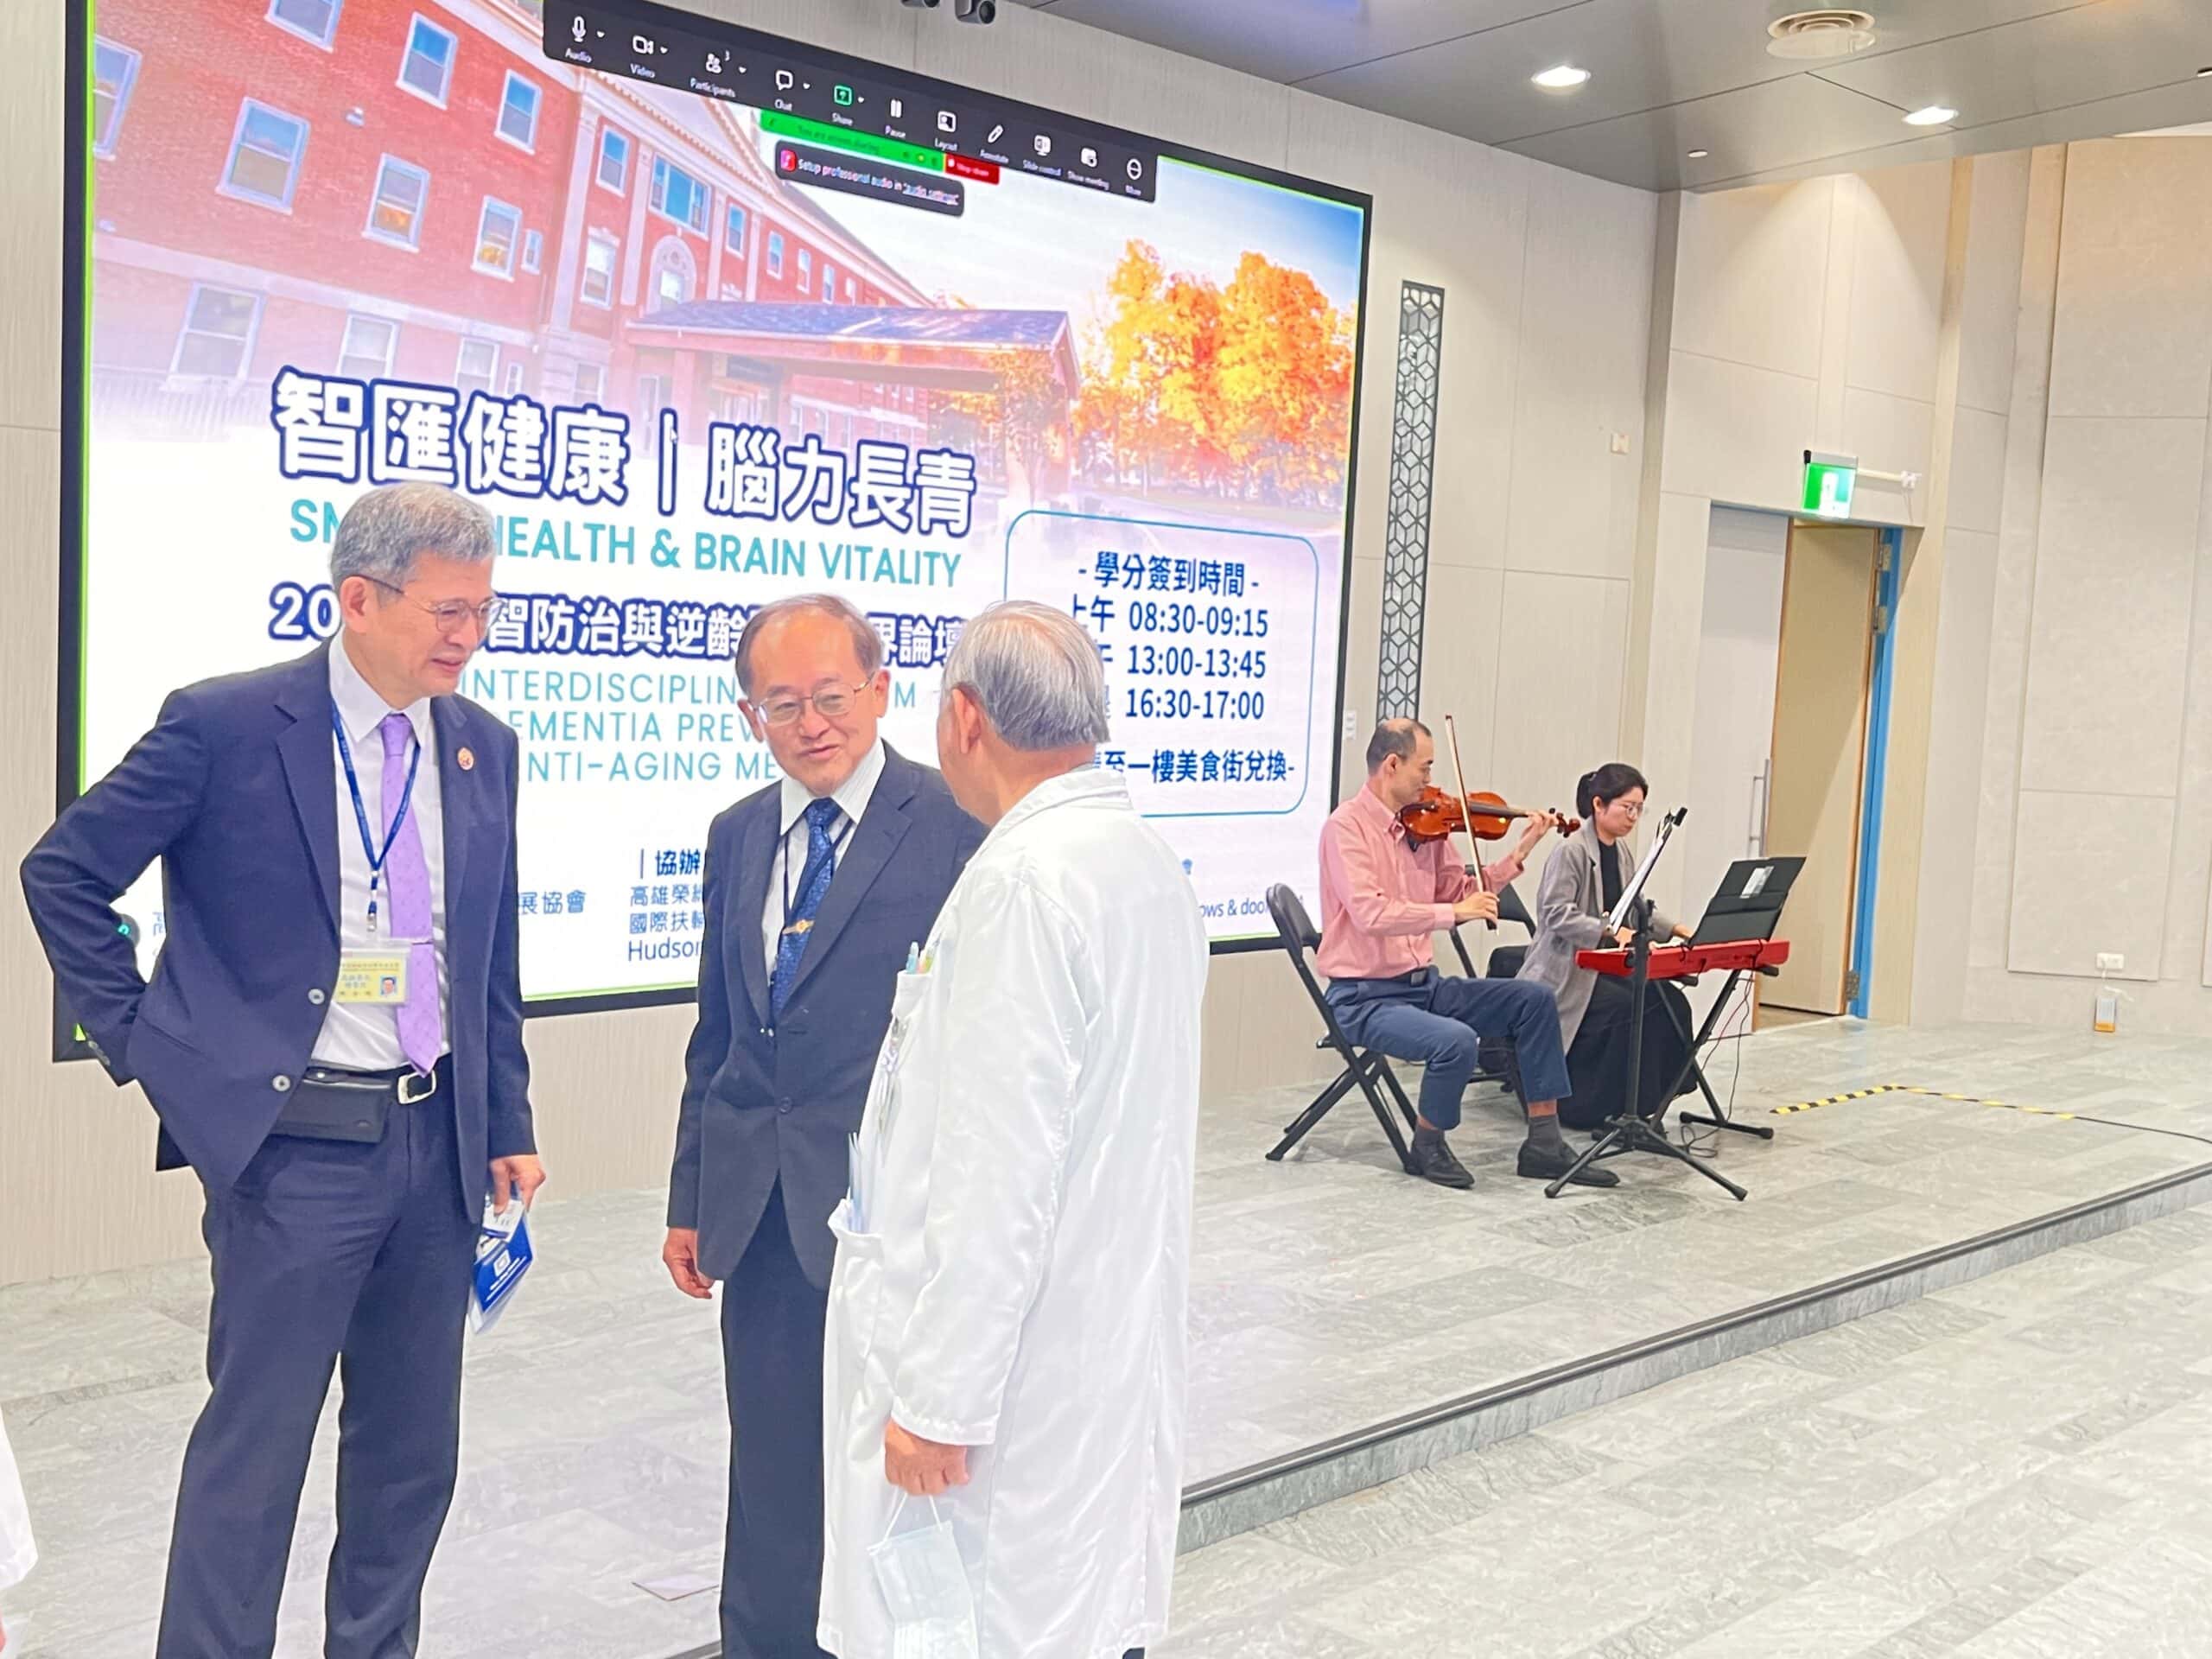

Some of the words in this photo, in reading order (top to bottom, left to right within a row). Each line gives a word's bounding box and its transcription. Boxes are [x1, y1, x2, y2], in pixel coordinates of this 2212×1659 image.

[629, 62, 656, 79] Video
[270, 365, 631, 507] 智匯健康
[704, 422, 977, 537] 腦力長青
[497, 516, 634, 564] EALTH
[650, 528, 682, 569] &
[695, 532, 805, 577] BRAIN
[818, 542, 961, 588] VITALITY
[1094, 550, 1245, 597] 學分簽到時間
[1128, 601, 1268, 638] 08:30-09:15
[1127, 645, 1267, 678] 13:00-13:45
[461, 669, 735, 705] INTERDISCIPLIN
[1125, 688, 1265, 720] 16:30-17:00
[508, 710, 662, 742] EMENTIA
[527, 751, 721, 782] NTI-AGING
[1094, 748, 1295, 784] 至一樓美食街兌換-
[1227, 899, 1237, 916] &
[1240, 897, 1270, 916] doo
